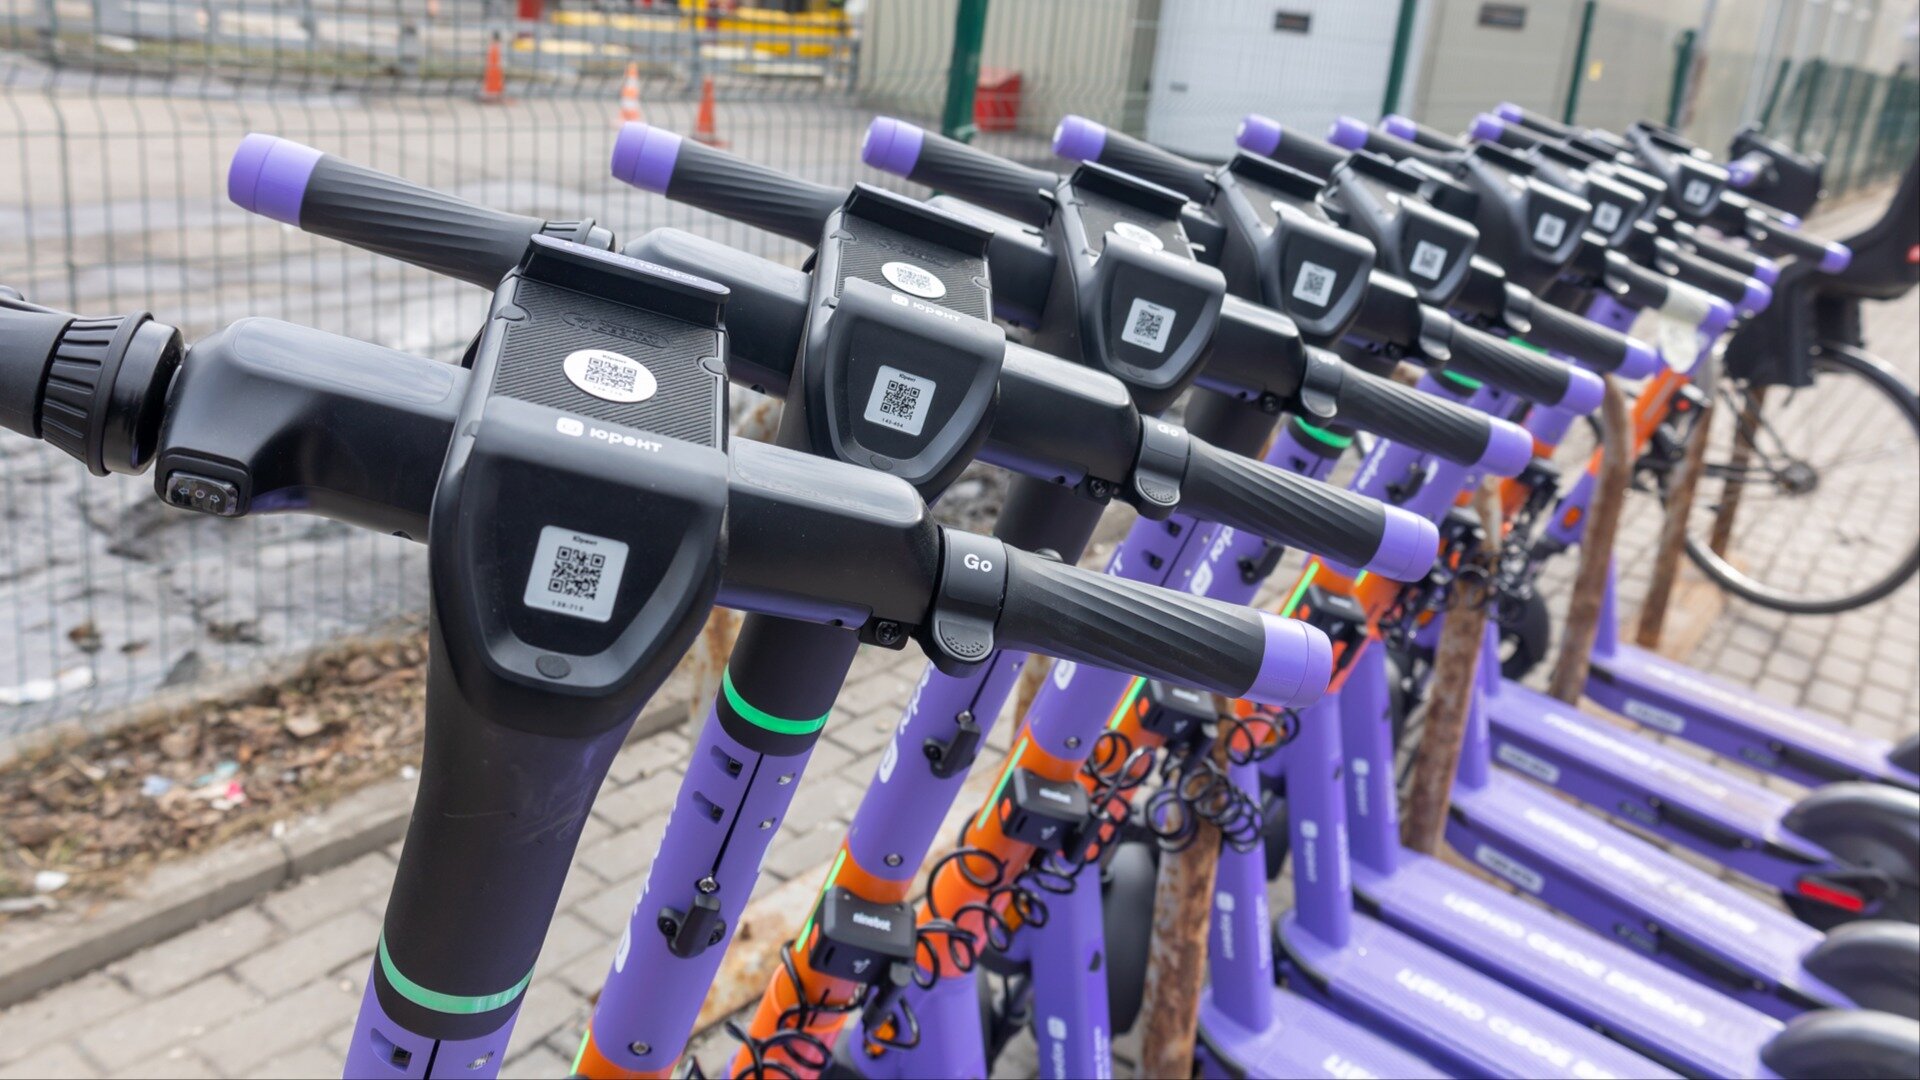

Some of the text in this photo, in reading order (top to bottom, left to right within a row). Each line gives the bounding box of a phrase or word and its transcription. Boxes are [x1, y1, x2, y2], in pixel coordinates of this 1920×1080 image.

[911, 302, 961, 322] юрент
[589, 427, 663, 453] юрент
[1157, 423, 1180, 438] Go
[963, 553, 994, 573] Go
